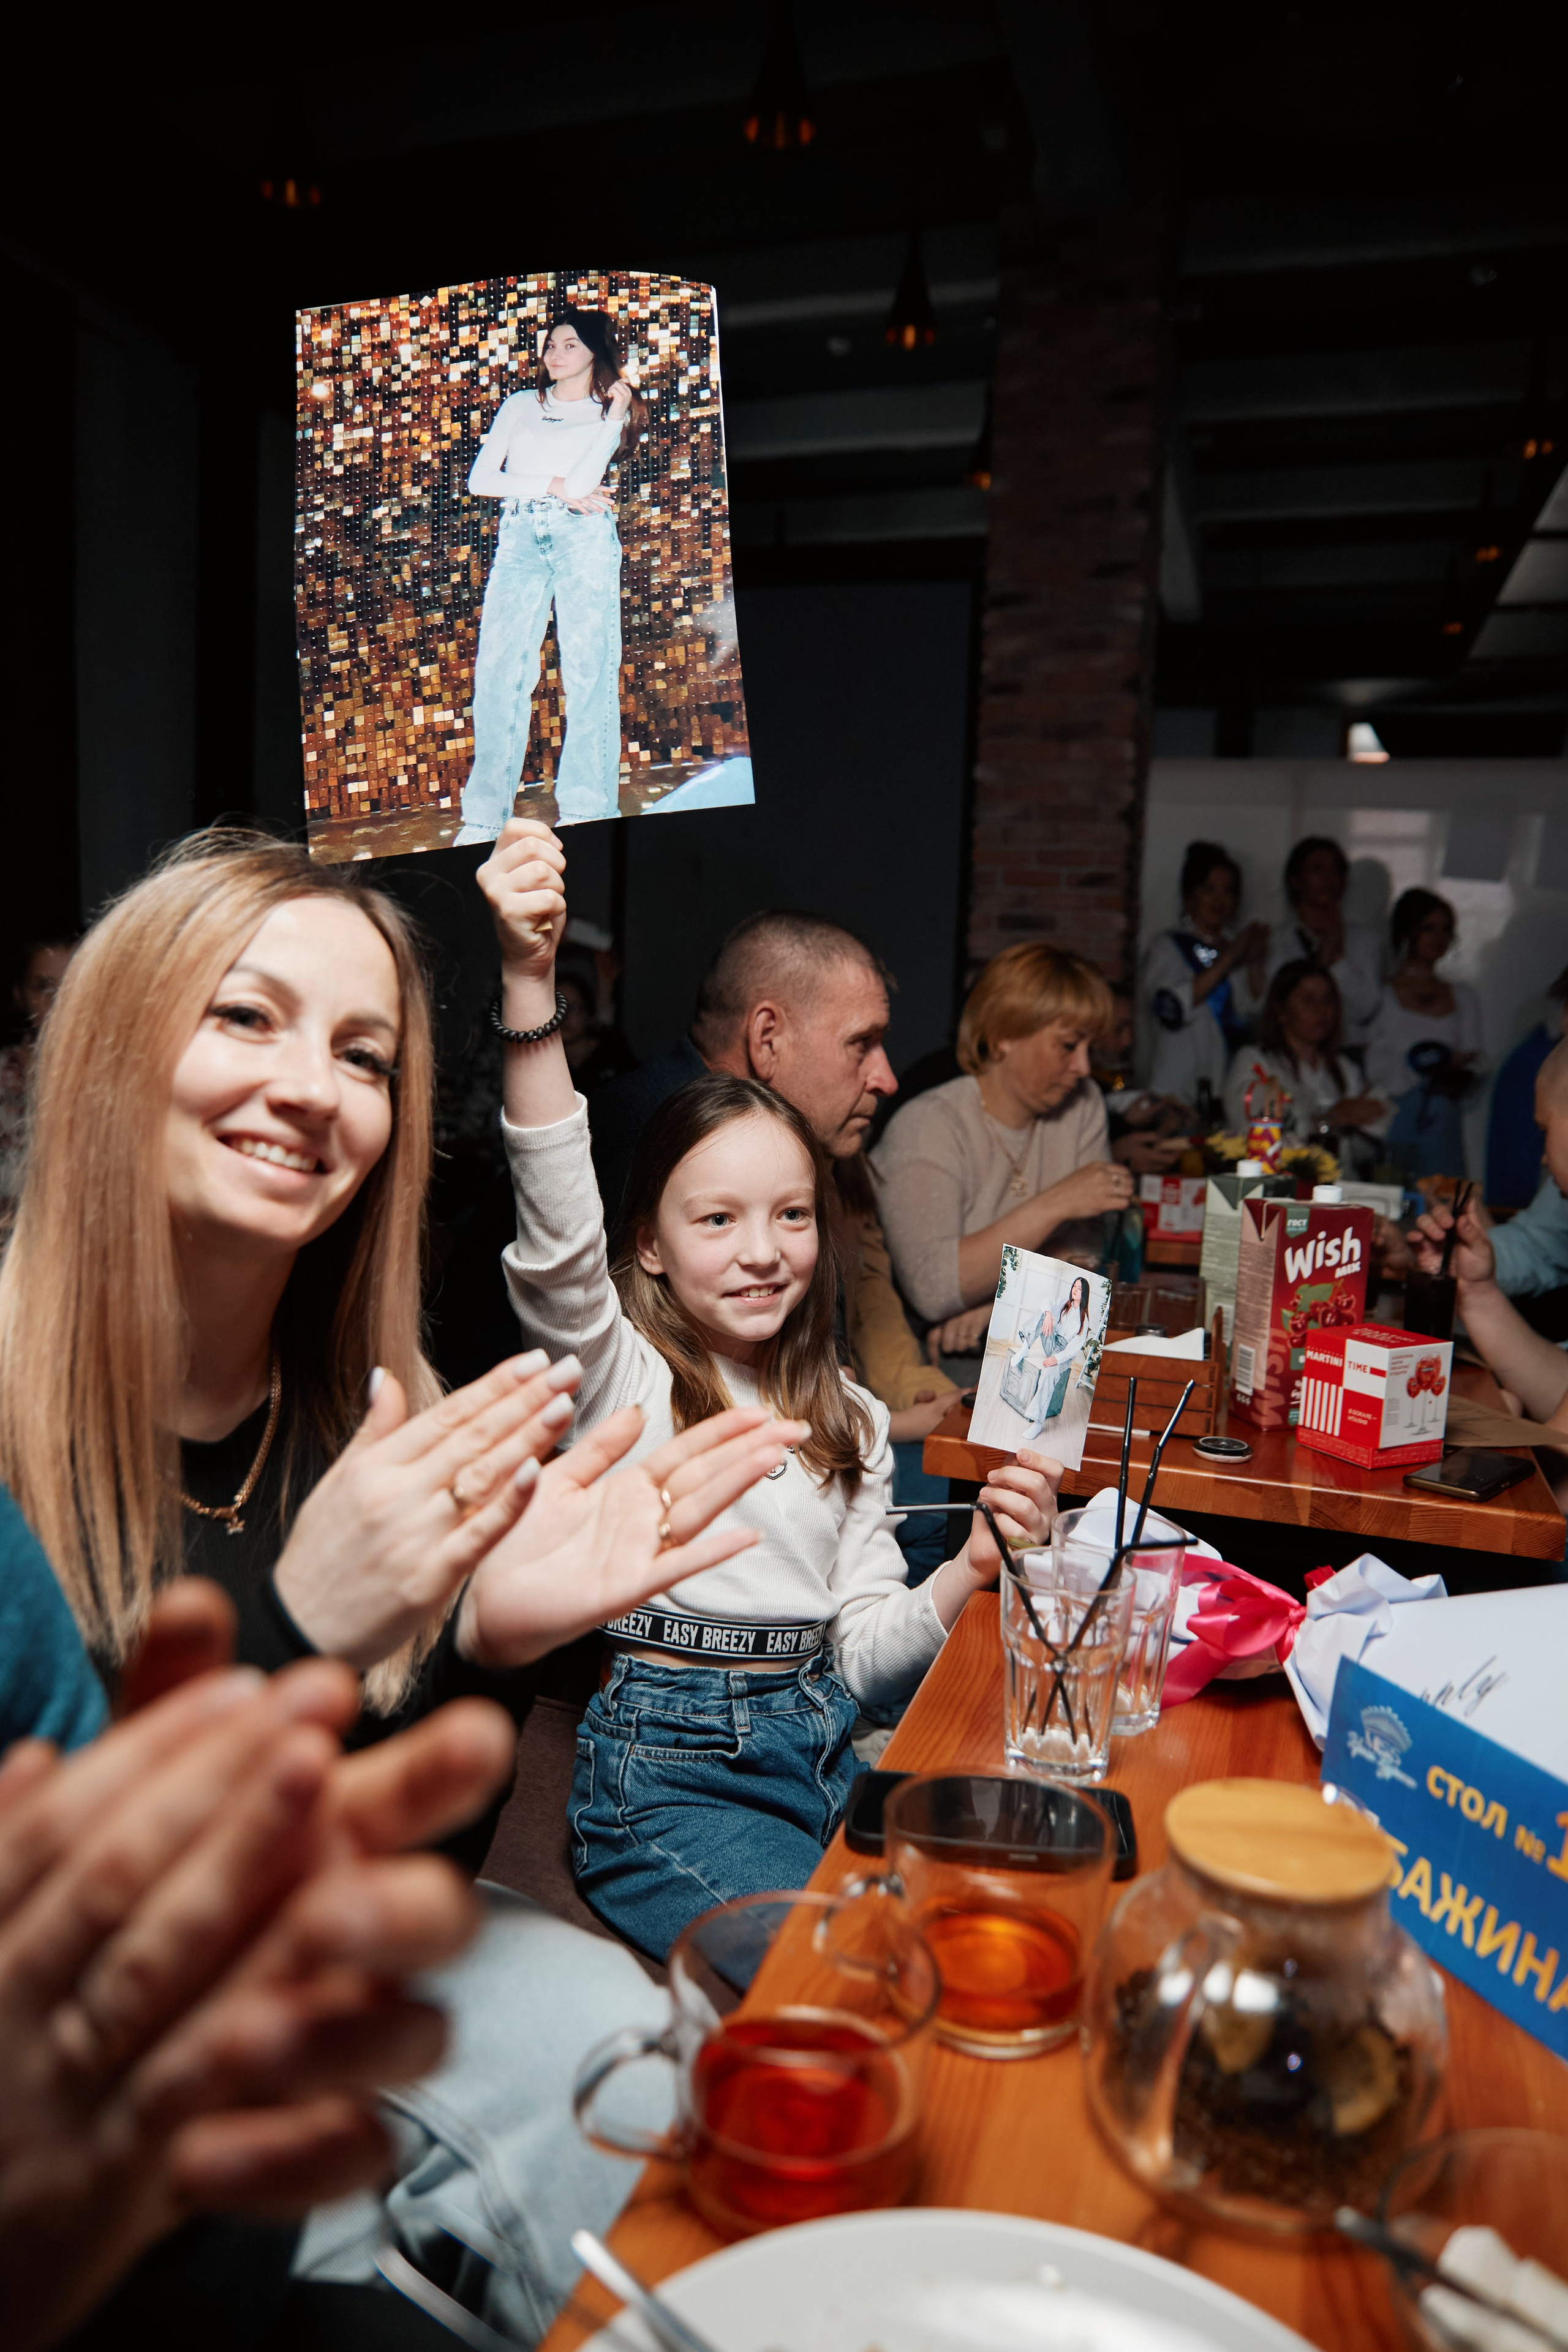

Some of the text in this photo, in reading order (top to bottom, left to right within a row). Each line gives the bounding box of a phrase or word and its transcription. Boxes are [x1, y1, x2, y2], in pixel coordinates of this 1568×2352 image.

[1284, 1226, 1362, 1284] Wish
[1306, 1350, 1368, 1373] MARTINI TIME
[663, 1620, 699, 1647] EASY
[701, 1627, 756, 1653] BREEZY
[766, 1632, 799, 1653] EASY
[1427, 1765, 1509, 1839] СТОЛ
[1385, 1833, 1568, 2013] АЖИН
